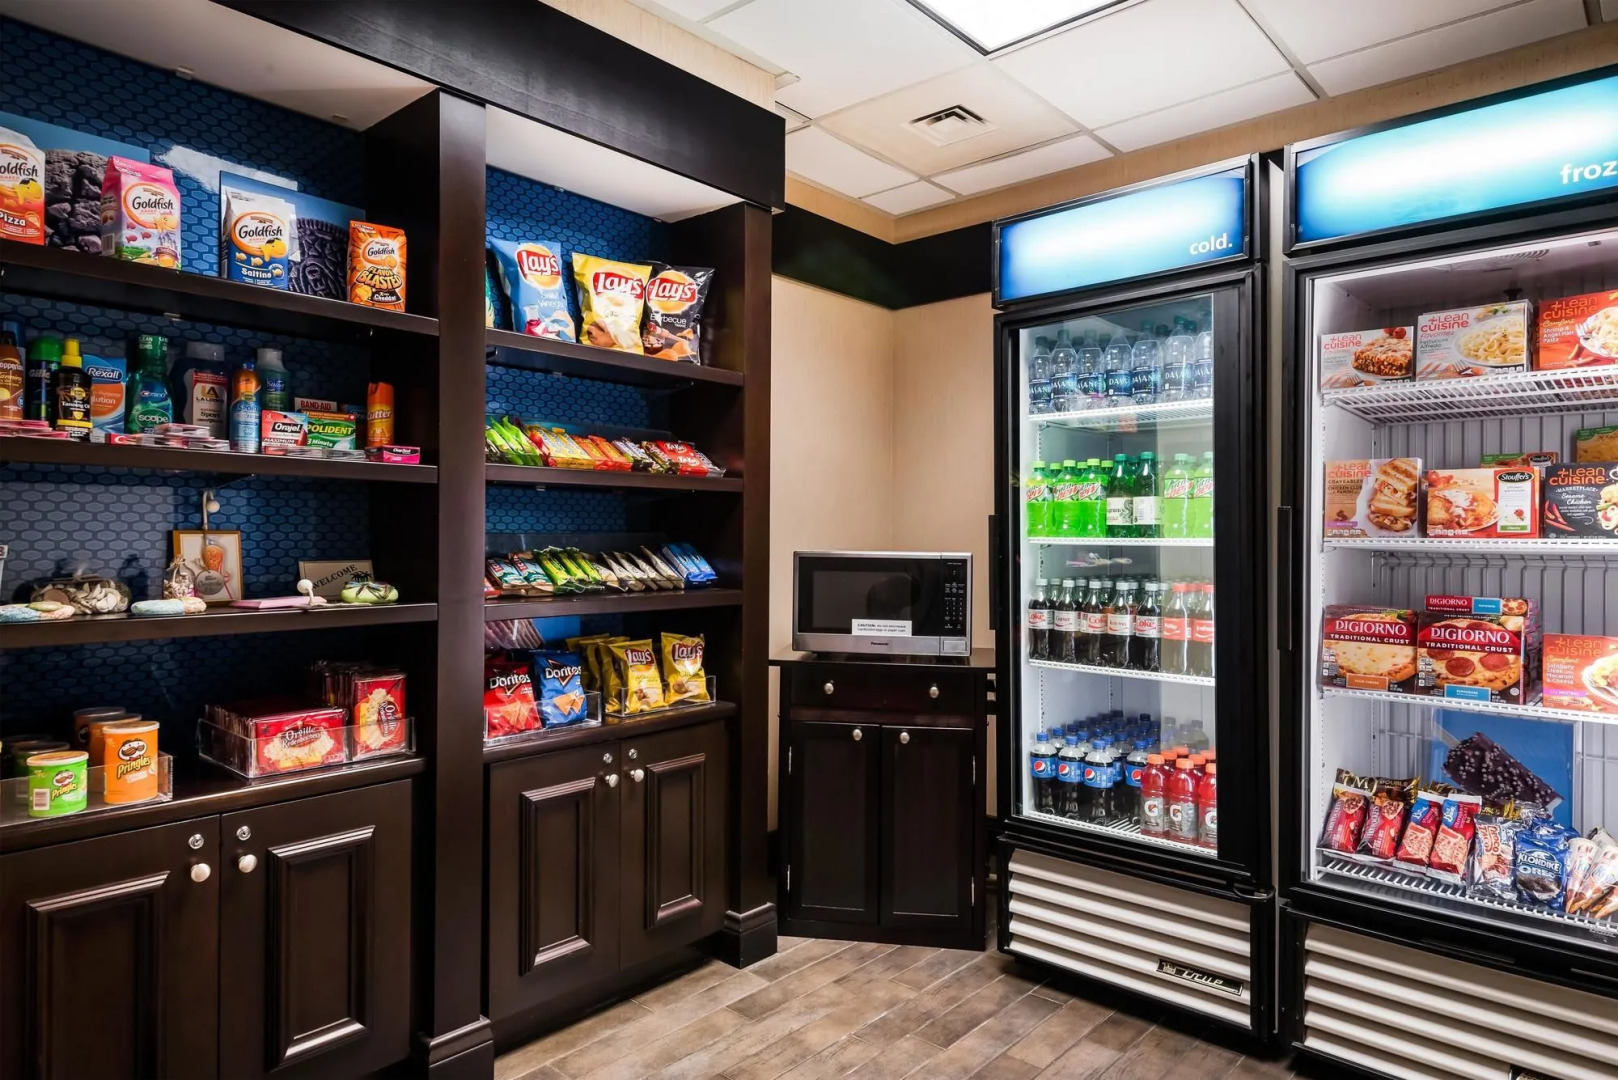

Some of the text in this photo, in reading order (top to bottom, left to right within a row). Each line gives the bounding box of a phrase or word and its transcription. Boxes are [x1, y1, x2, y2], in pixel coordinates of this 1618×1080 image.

[1560, 162, 1618, 184] froz
[132, 196, 174, 211] Goldfish
[238, 224, 283, 239] Goldfish
[367, 246, 395, 256] Goldfish
[1190, 233, 1232, 255] cold.
[521, 252, 560, 276] Lay's
[241, 267, 272, 279] Saltine
[359, 270, 402, 289] BLASTED
[597, 274, 642, 296] Lay's
[650, 278, 697, 300] Lay's
[1562, 296, 1599, 310] Lean
[650, 312, 687, 326] Brbecue
[1438, 312, 1469, 324] Lean
[88, 366, 120, 380] Rexall
[138, 413, 168, 424] scope
[274, 423, 300, 433] Orajel
[307, 424, 353, 434] POLIDENT
[312, 438, 334, 447] Minute
[1500, 472, 1530, 482] Stouffer's
[1549, 474, 1606, 486] cuisine
[1569, 468, 1606, 477] Lean
[312, 564, 358, 590] WELCOME
[1430, 598, 1468, 606] DIGIORNO
[1335, 620, 1407, 636] DIGIORNO
[1330, 634, 1381, 642] TRADITIONAL
[1431, 628, 1510, 644] DIGIORNO
[674, 643, 702, 659] Lay's
[1425, 642, 1514, 653] TRADITIONAL CRUST
[627, 649, 651, 665] Lay's
[545, 664, 581, 679] Doritos
[490, 674, 531, 690] Doritos
[286, 727, 316, 741] Orville
[117, 756, 151, 780] Pringles
[52, 782, 78, 800] Pringles
[1144, 800, 1158, 817] G
[1170, 805, 1182, 822] G
[1518, 852, 1560, 872] KLONDIKE
[1518, 866, 1556, 879] OREO
